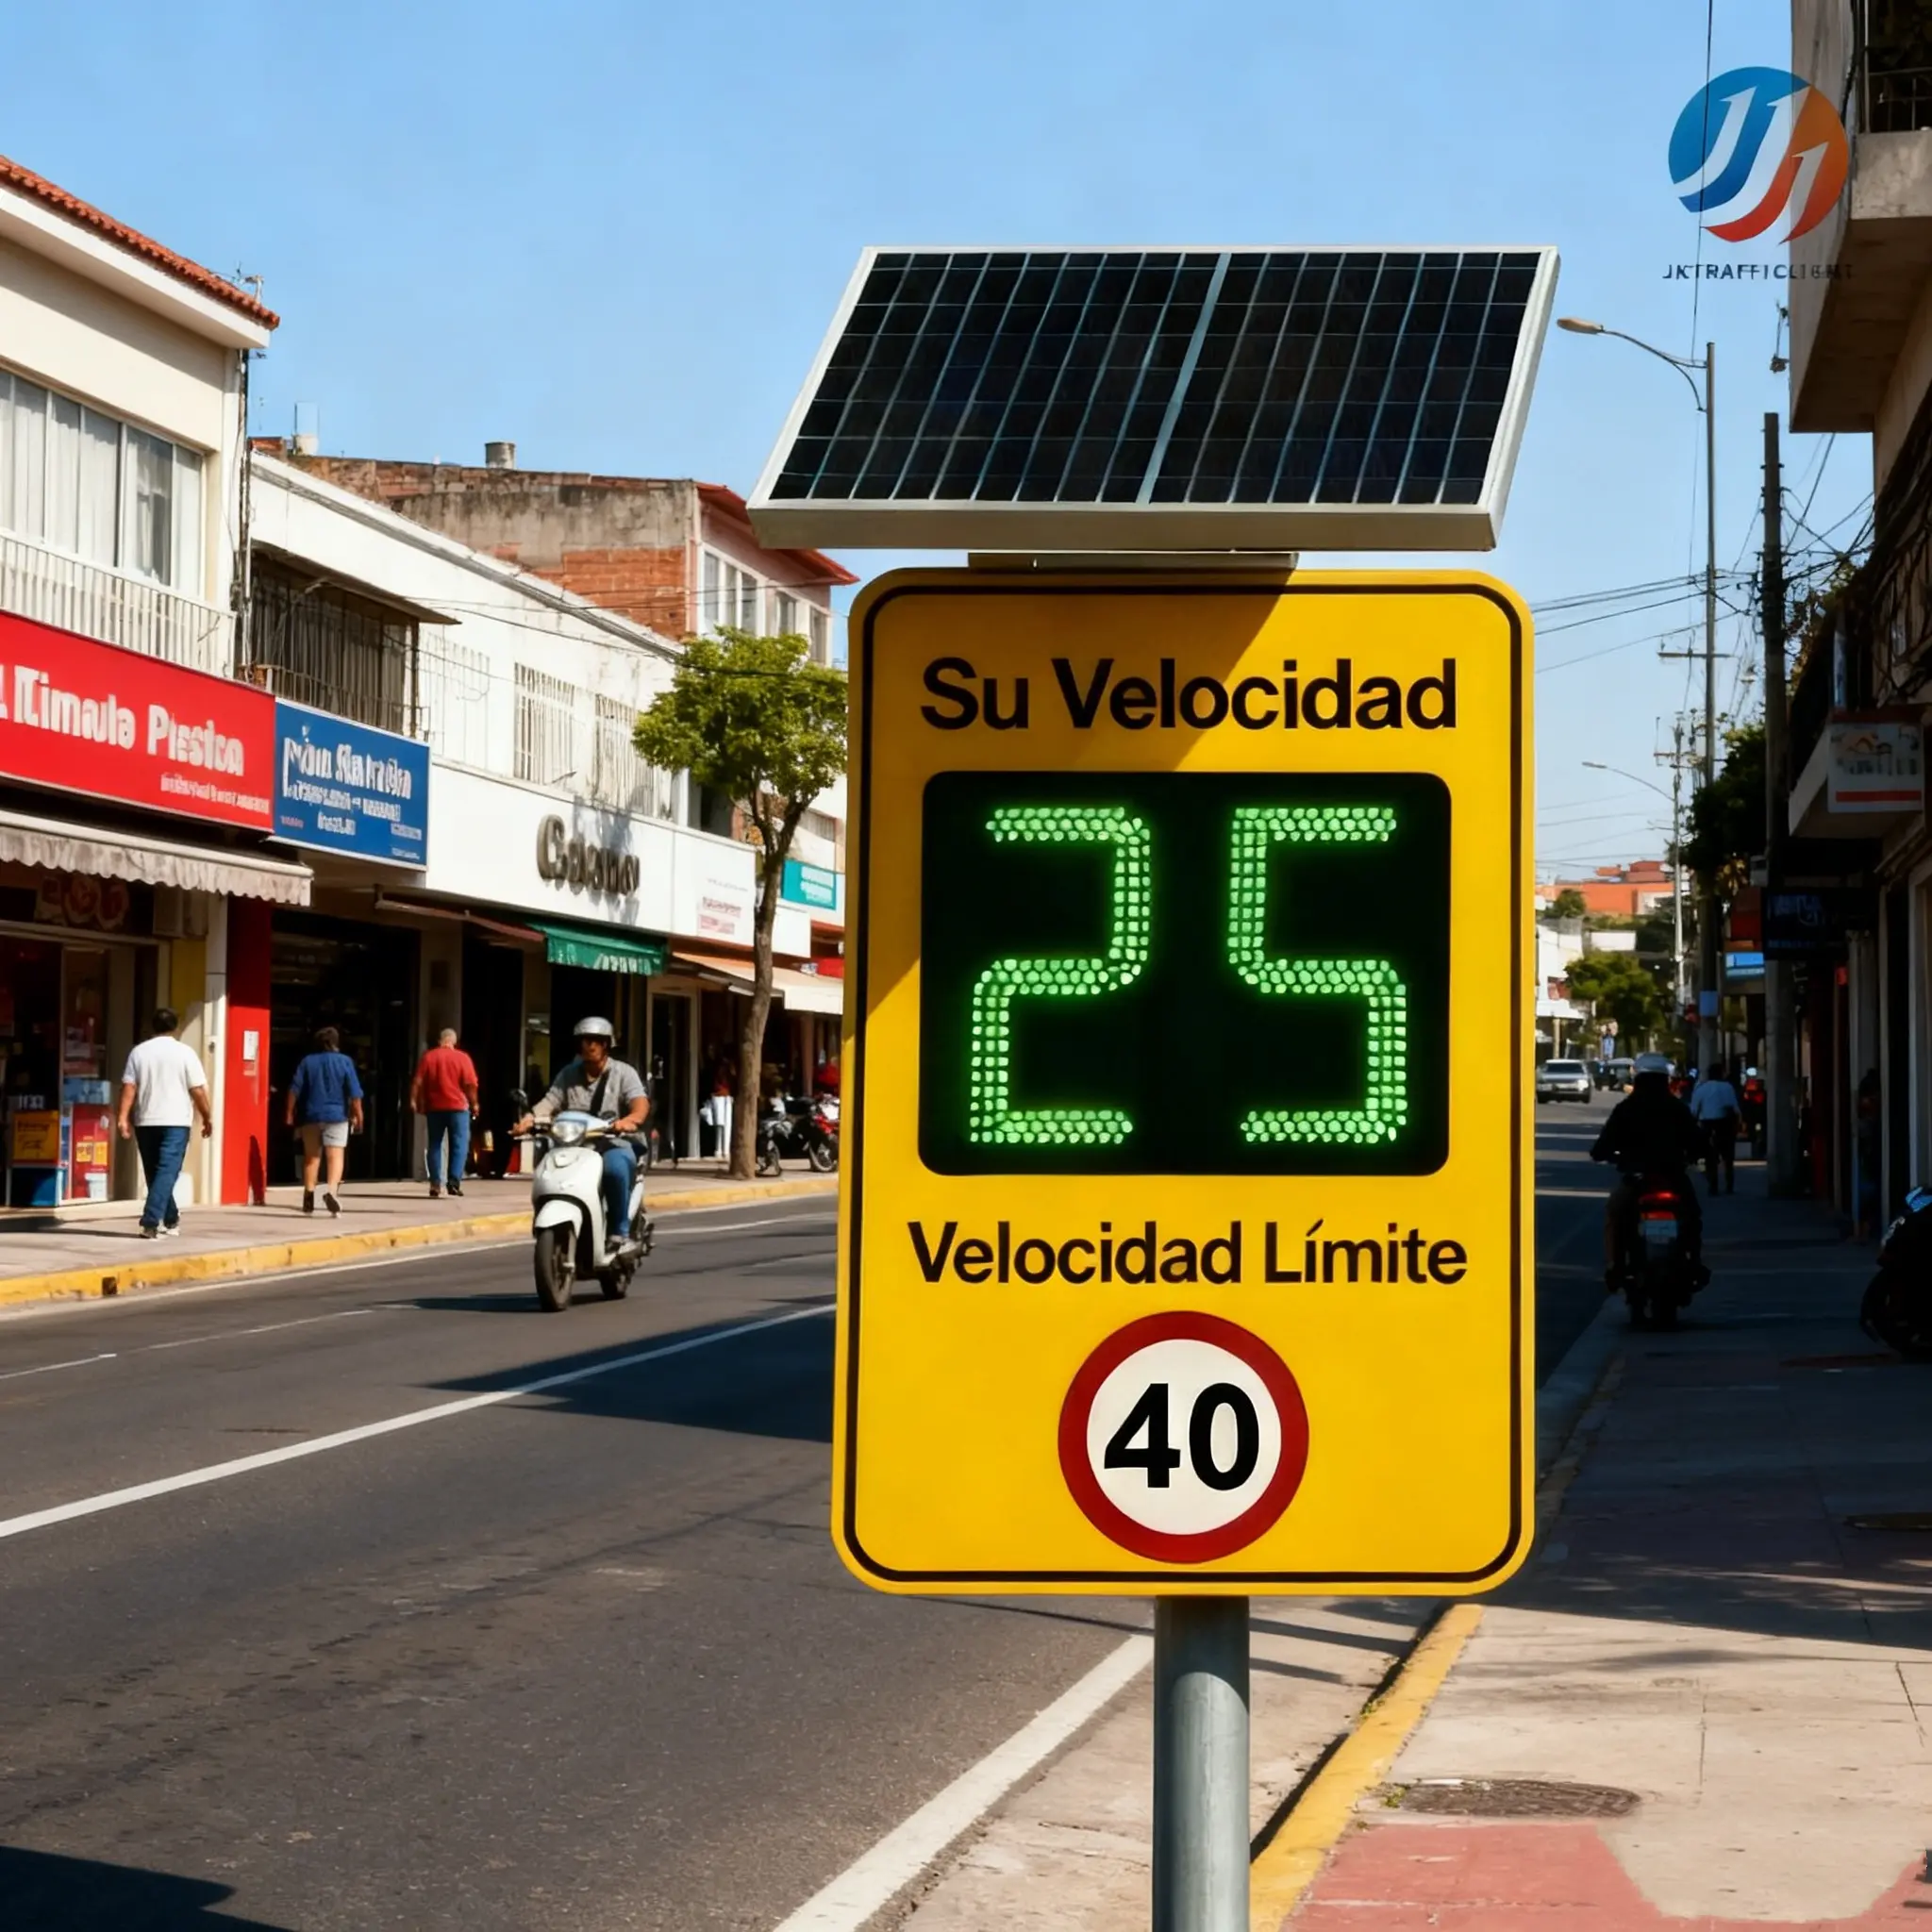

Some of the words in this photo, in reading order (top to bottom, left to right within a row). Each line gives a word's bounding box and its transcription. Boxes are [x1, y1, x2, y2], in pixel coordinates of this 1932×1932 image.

[921, 657, 1029, 730] Su
[1050, 657, 1456, 730] Velocidad
[970, 805, 1408, 1147] 25
[908, 1220, 1241, 1284] Velocidad
[1266, 1219, 1468, 1284] Límite
[1103, 1382, 1259, 1491] 40
